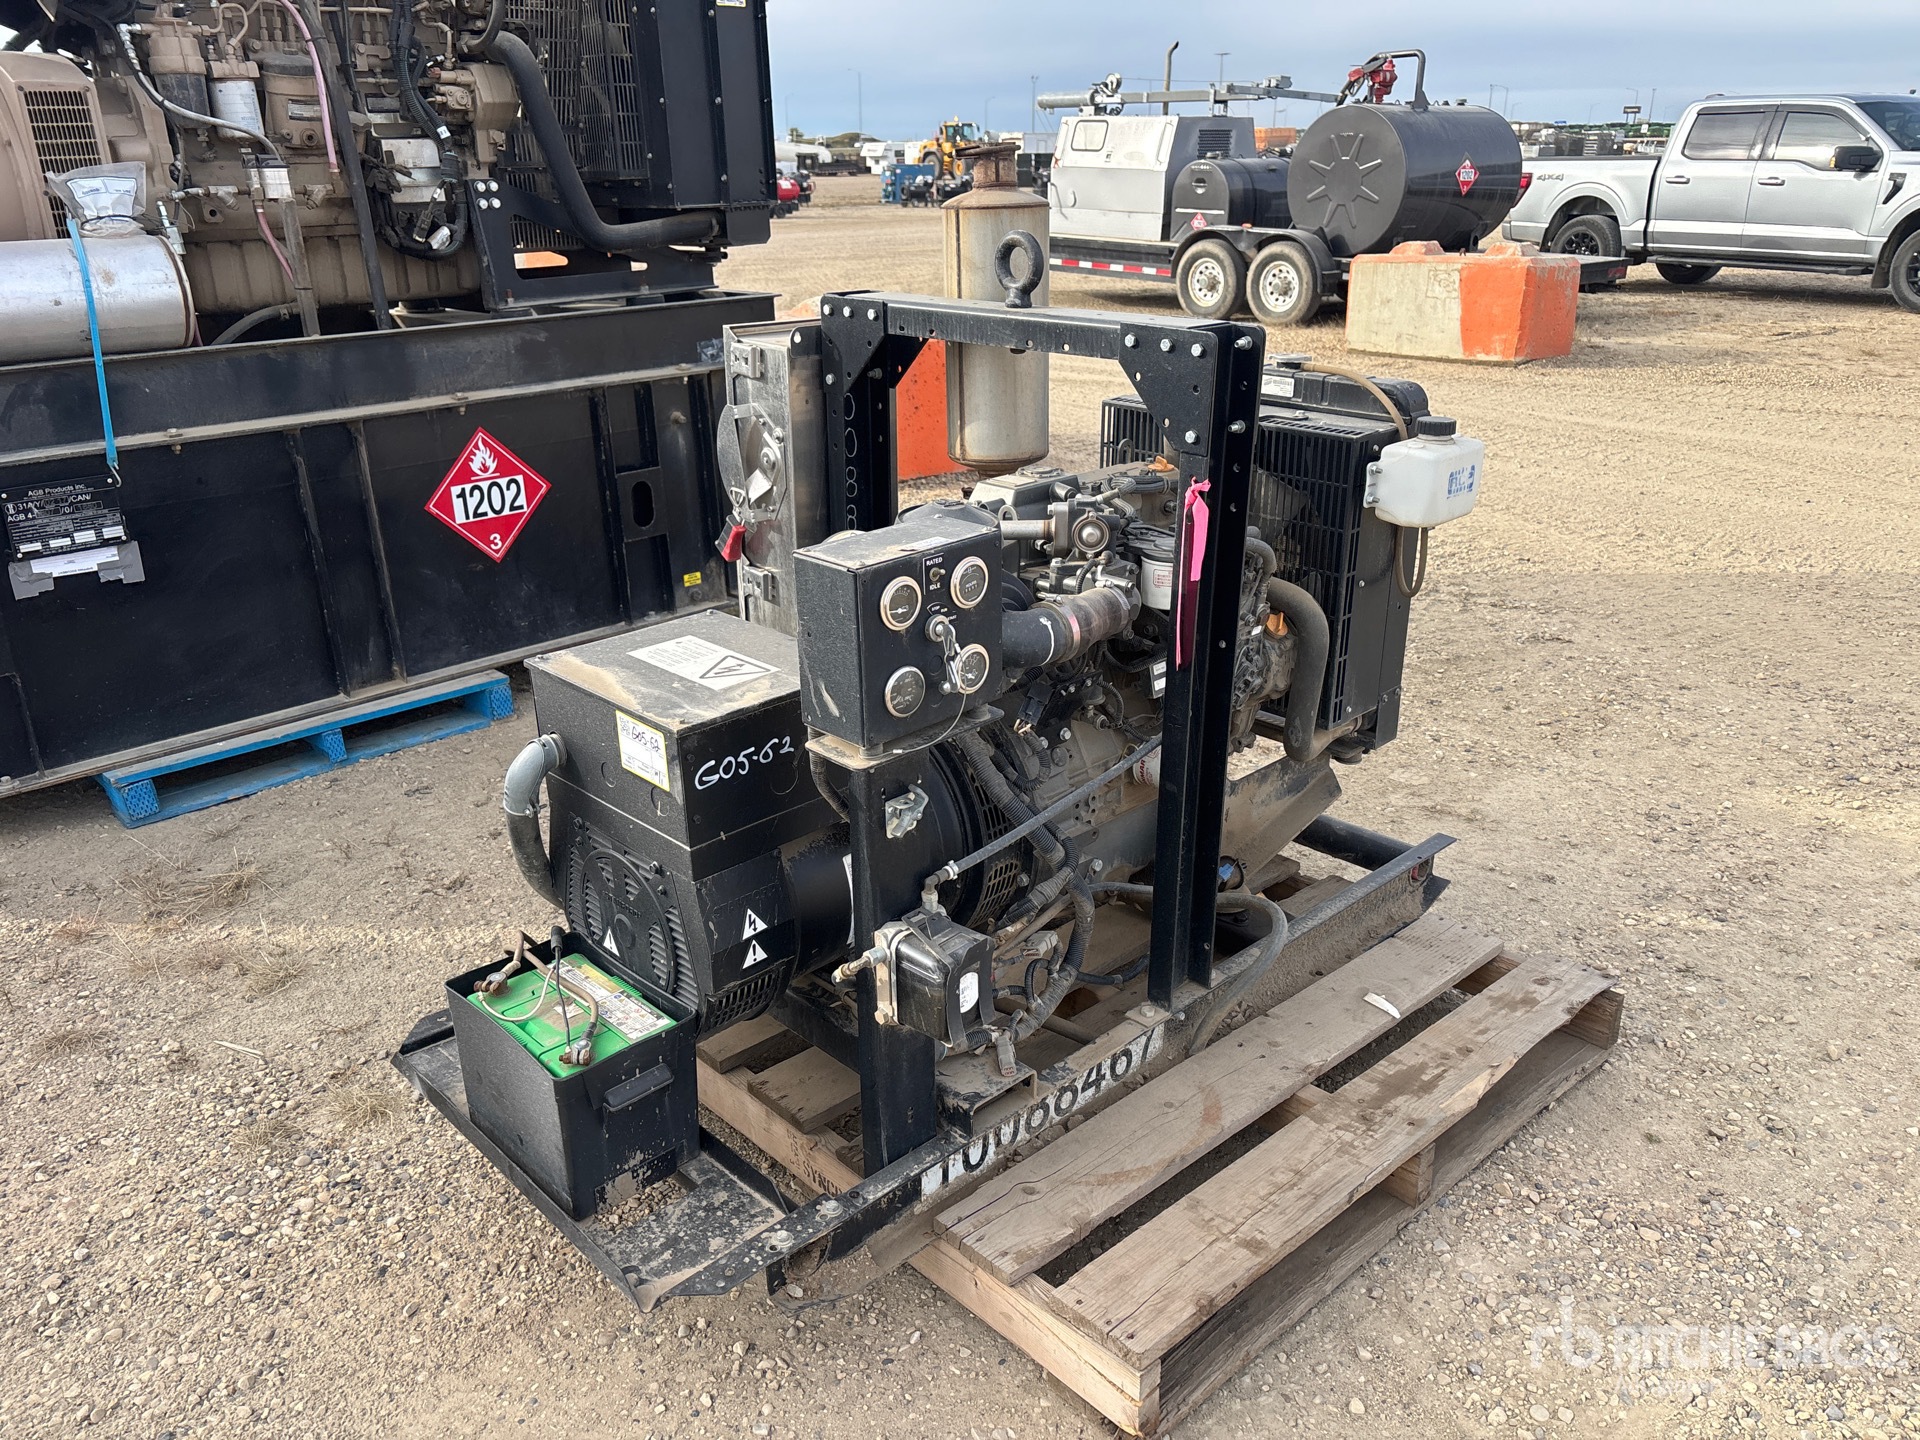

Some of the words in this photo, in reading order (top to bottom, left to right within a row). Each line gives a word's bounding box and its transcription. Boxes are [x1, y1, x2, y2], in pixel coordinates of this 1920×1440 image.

[1461, 169, 1475, 181] 1202
[28, 488, 44, 497] AGB
[45, 485, 74, 494] Products
[456, 477, 525, 521] 1202
[7, 513, 26, 523] AGB
[489, 533, 503, 550] 3
[926, 557, 943, 566] RATED
[929, 583, 941, 591] IDLE
